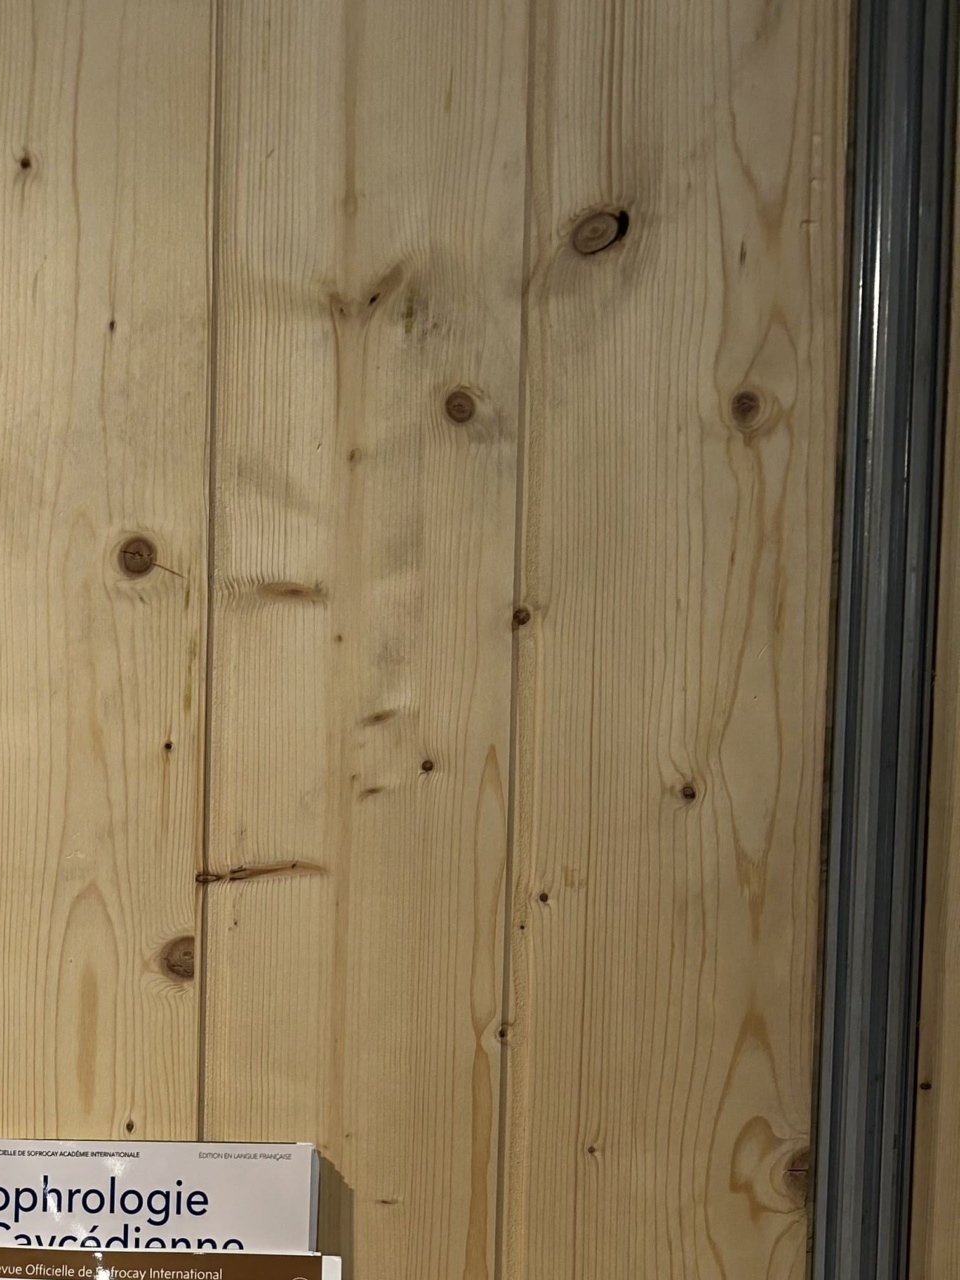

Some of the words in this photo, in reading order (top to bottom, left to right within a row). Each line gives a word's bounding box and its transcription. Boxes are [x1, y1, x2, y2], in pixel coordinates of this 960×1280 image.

[259, 1153, 292, 1161] FRANÇAISE
[25, 1264, 75, 1277] Officielle
[78, 1266, 93, 1278] de
[95, 1266, 146, 1280] frocay
[149, 1268, 223, 1280] International
